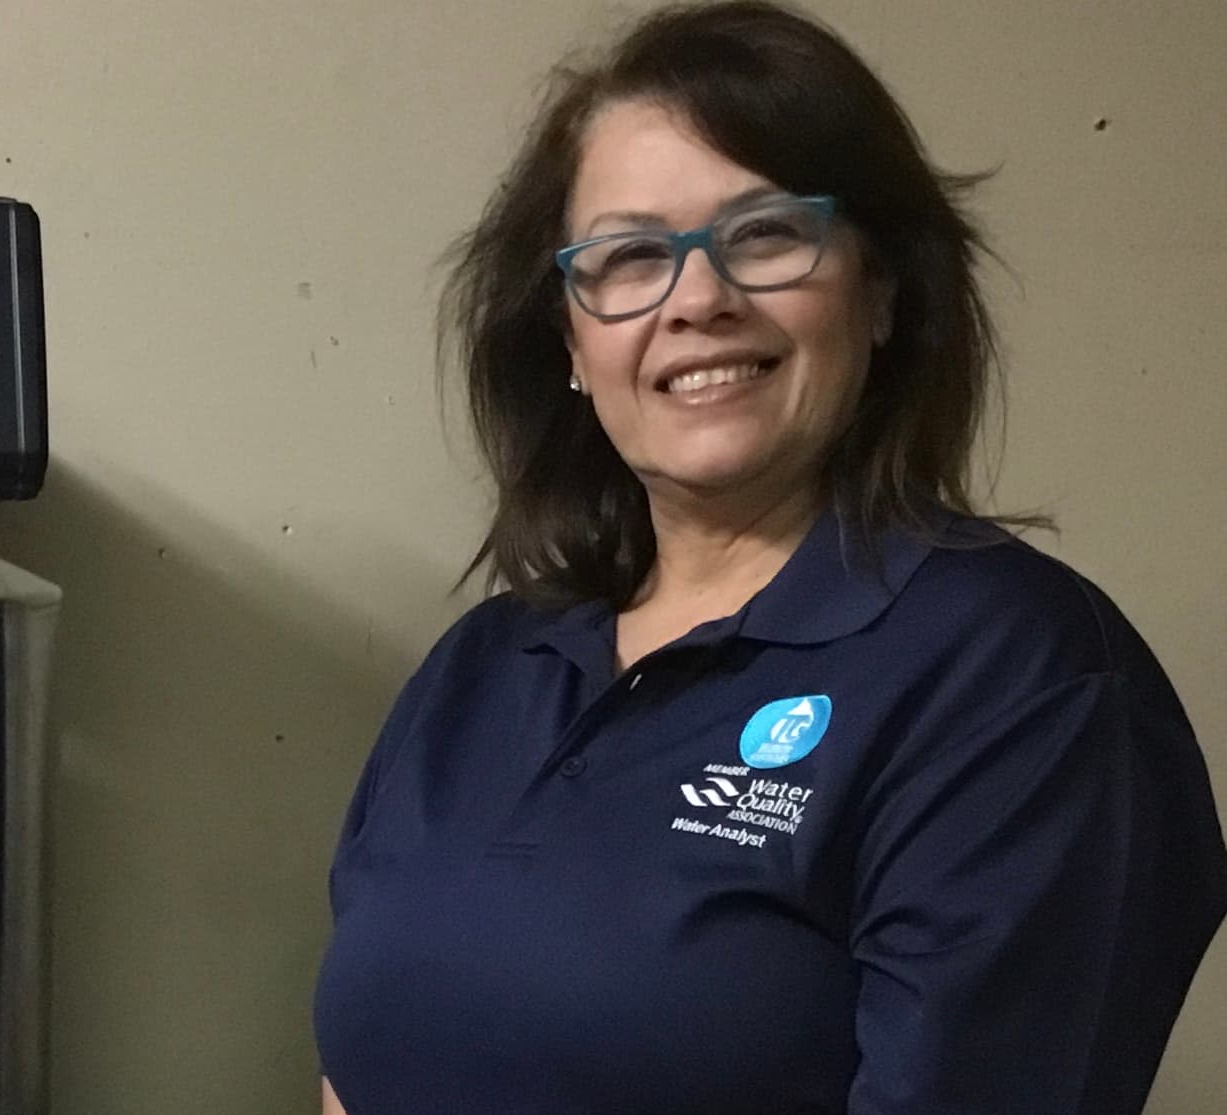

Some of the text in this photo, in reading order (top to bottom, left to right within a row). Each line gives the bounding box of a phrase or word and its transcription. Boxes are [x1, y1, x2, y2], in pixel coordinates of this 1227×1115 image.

[703, 763, 751, 777] MEMBER
[748, 779, 814, 804] Water
[736, 793, 806, 823] Quality
[671, 817, 767, 849] Water Analyst
[725, 809, 799, 836] ASSOCIATION
